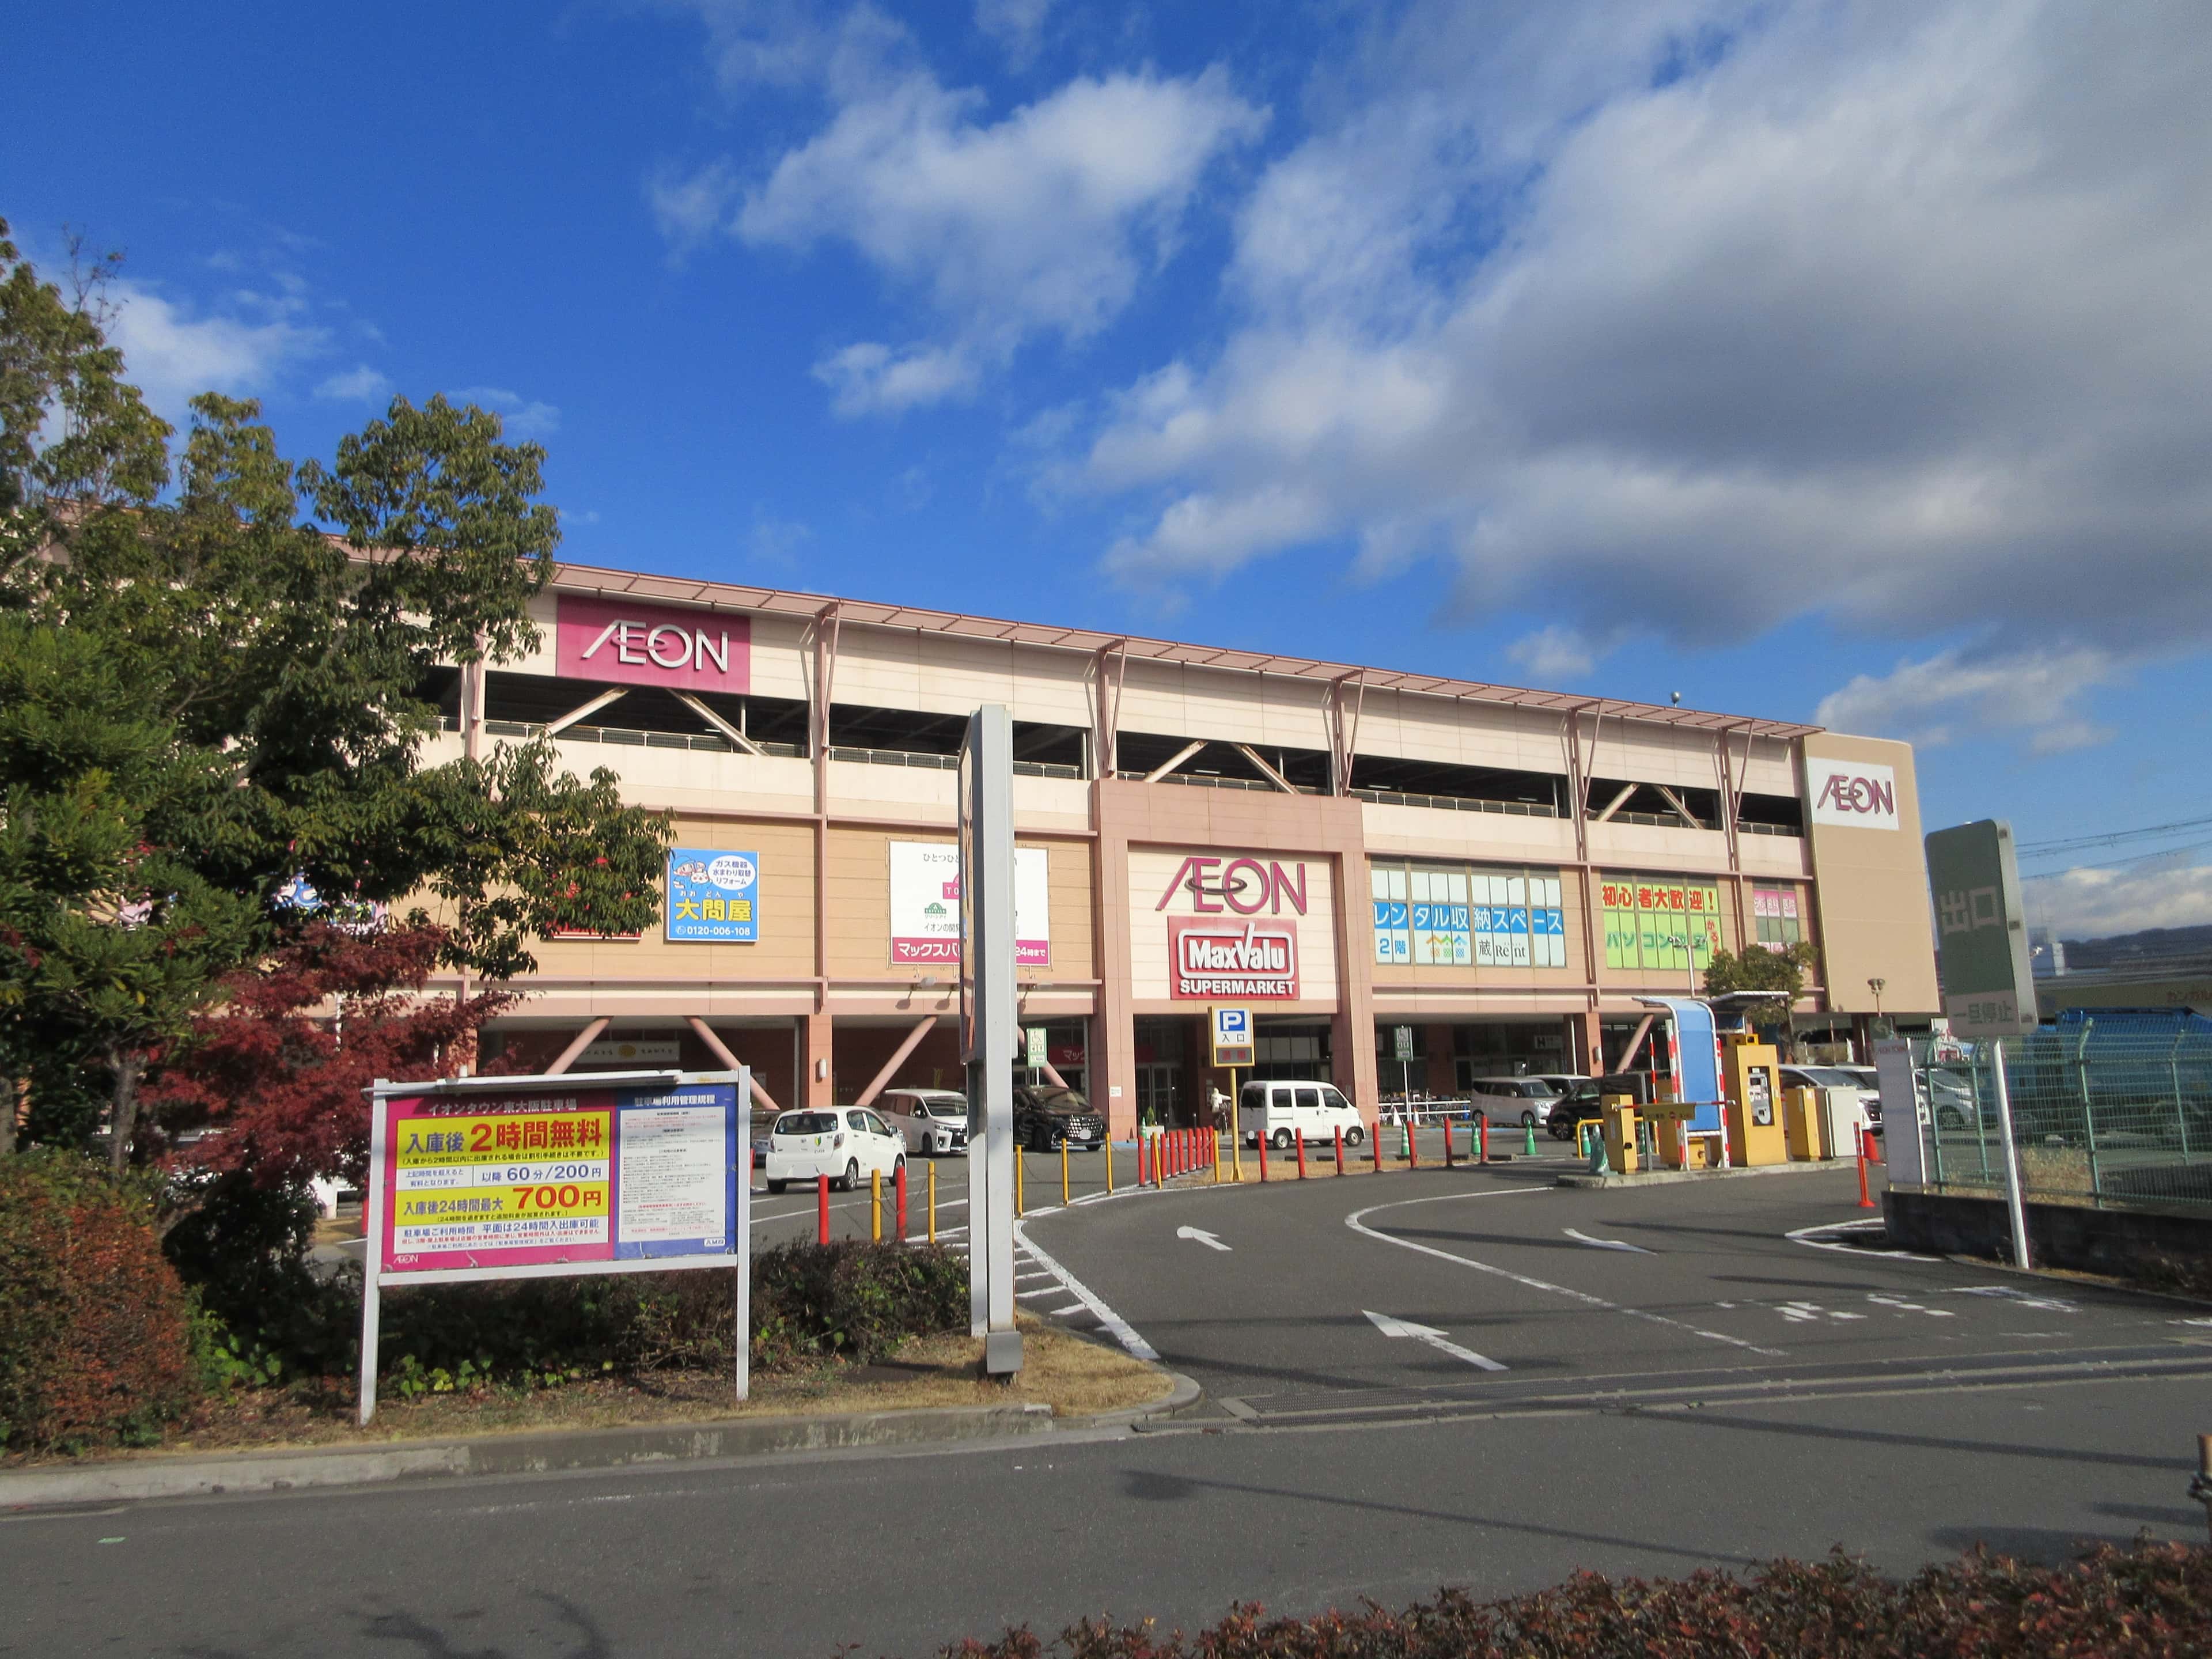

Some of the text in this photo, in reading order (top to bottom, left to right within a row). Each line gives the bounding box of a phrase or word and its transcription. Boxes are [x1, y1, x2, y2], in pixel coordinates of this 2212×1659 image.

[717, 877, 747, 885] リフォーム
[675, 897, 752, 922] 大問屋
[1373, 904, 1563, 931] レンタル収納スペース
[1940, 885, 2001, 936] 出口
[1188, 922, 1285, 970] MaxValu
[1380, 938, 1406, 955] 2階
[1180, 979, 1295, 995] SUPERMARKET
[1223, 1012, 1242, 1030] P
[1222, 1033, 1245, 1043] 入口
[429, 1099, 577, 1116] イオンタウン東大阪駐車場
